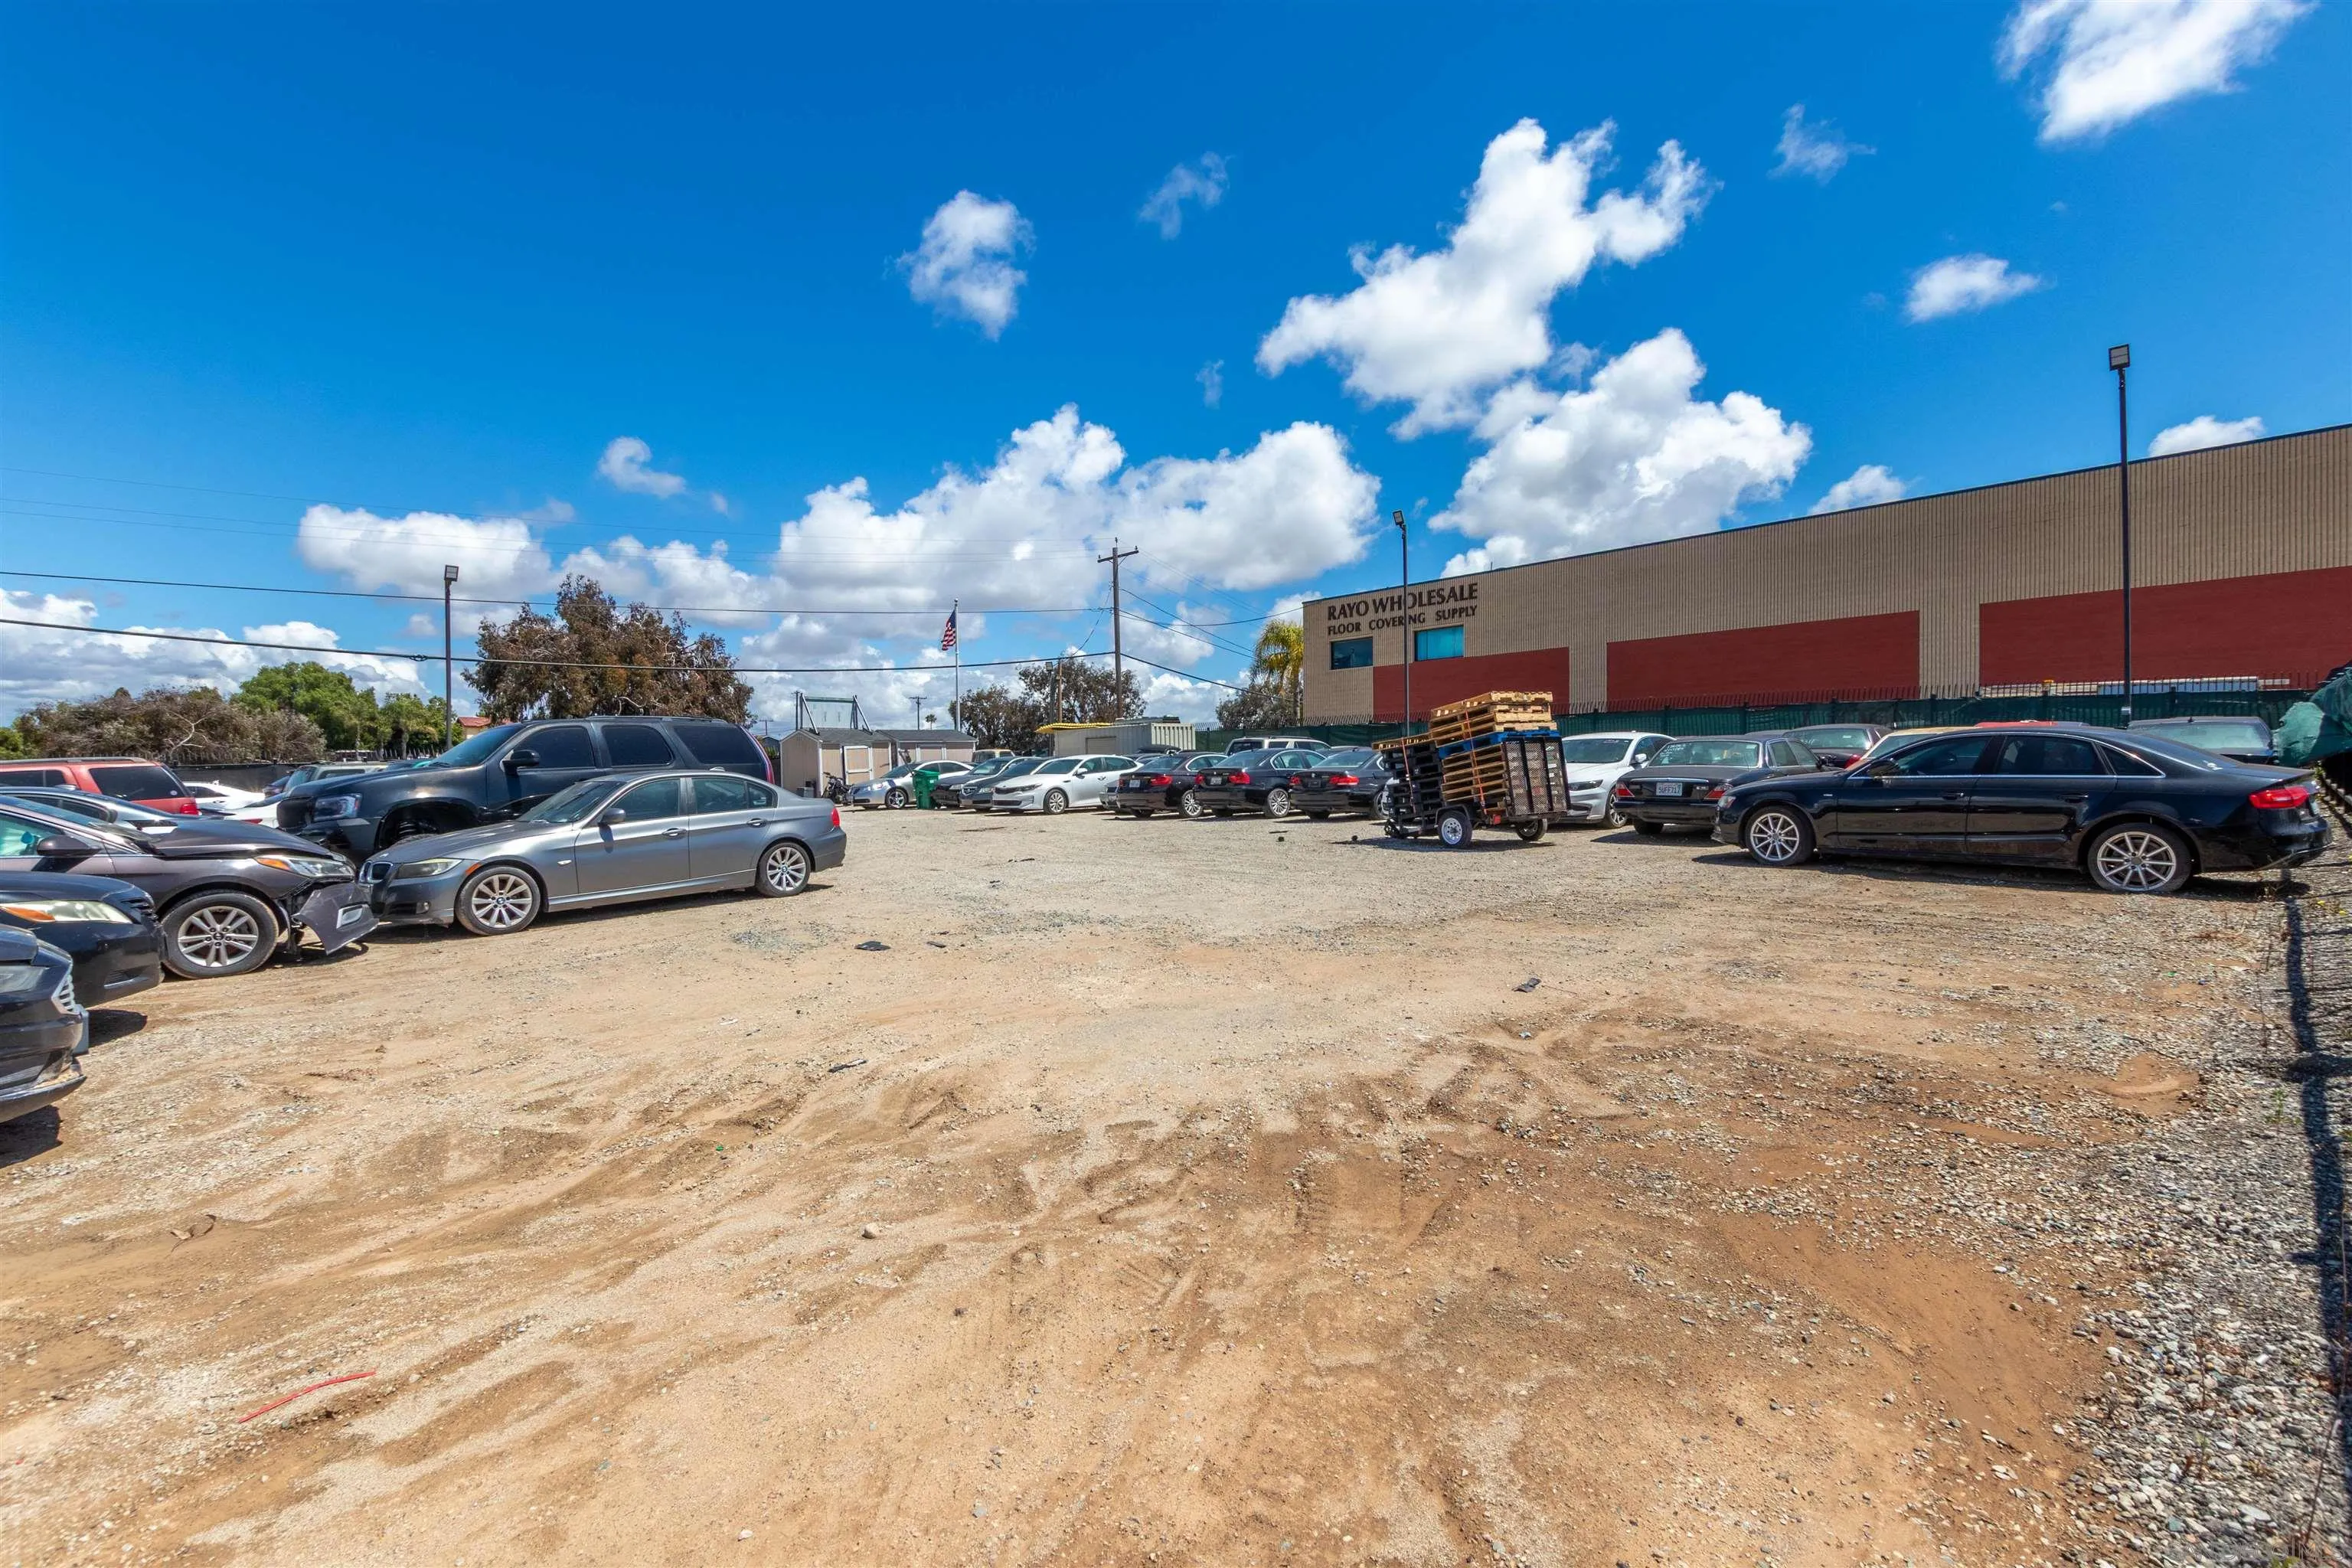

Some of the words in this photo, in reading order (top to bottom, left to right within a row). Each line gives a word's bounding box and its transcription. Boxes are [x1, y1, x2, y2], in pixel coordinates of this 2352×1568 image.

[1328, 600, 1369, 621] RAYO
[1372, 583, 1478, 614] WHOLESALE
[1328, 622, 1361, 636] FLOOR
[1368, 612, 1426, 630] COVERNG
[1436, 605, 1478, 621] SUPPLY
